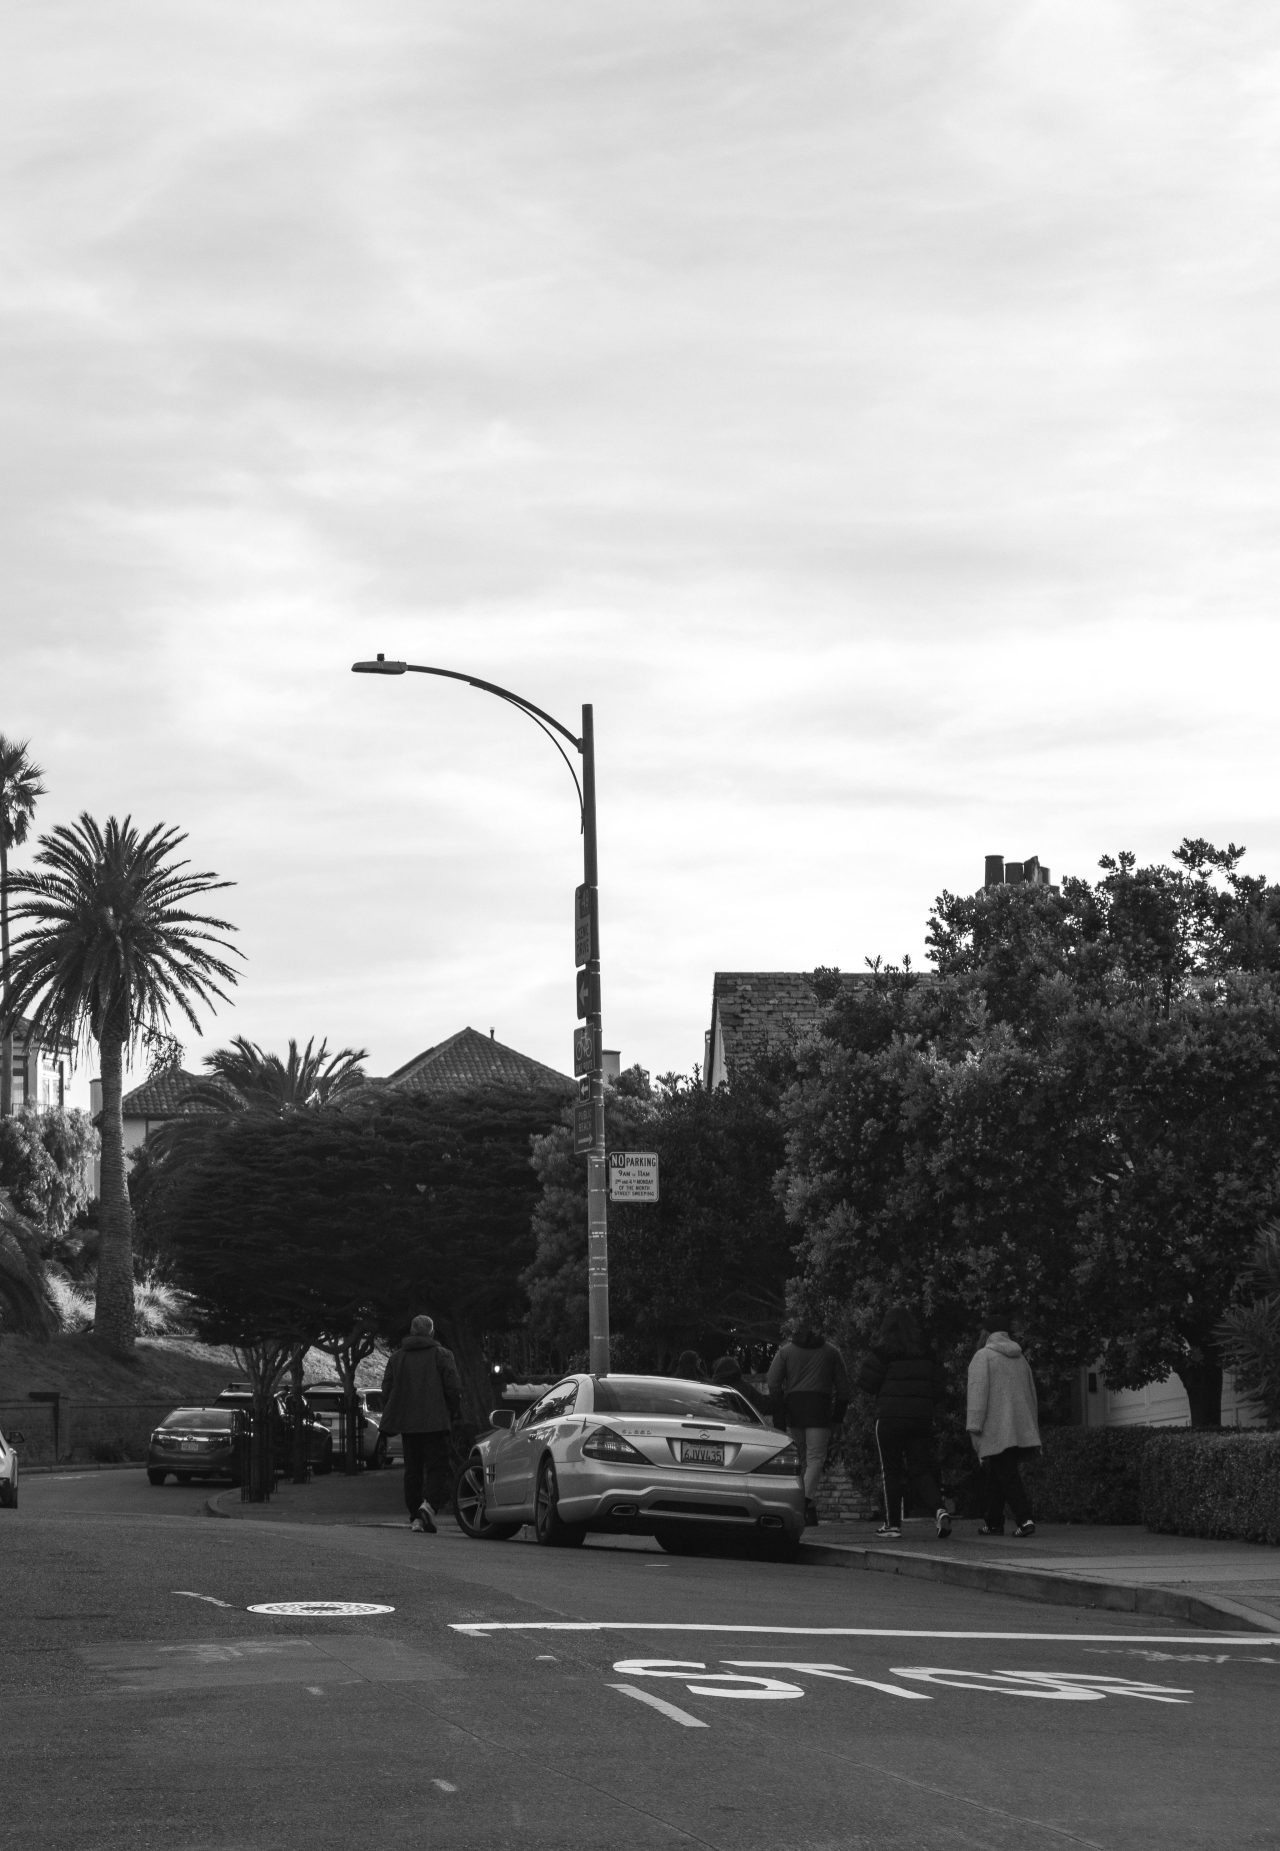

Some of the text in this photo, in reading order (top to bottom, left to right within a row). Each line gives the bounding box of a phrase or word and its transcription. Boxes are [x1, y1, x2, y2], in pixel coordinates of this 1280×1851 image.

[611, 1154, 656, 1167] NO PARKING
[612, 1659, 1193, 1704] STOP
